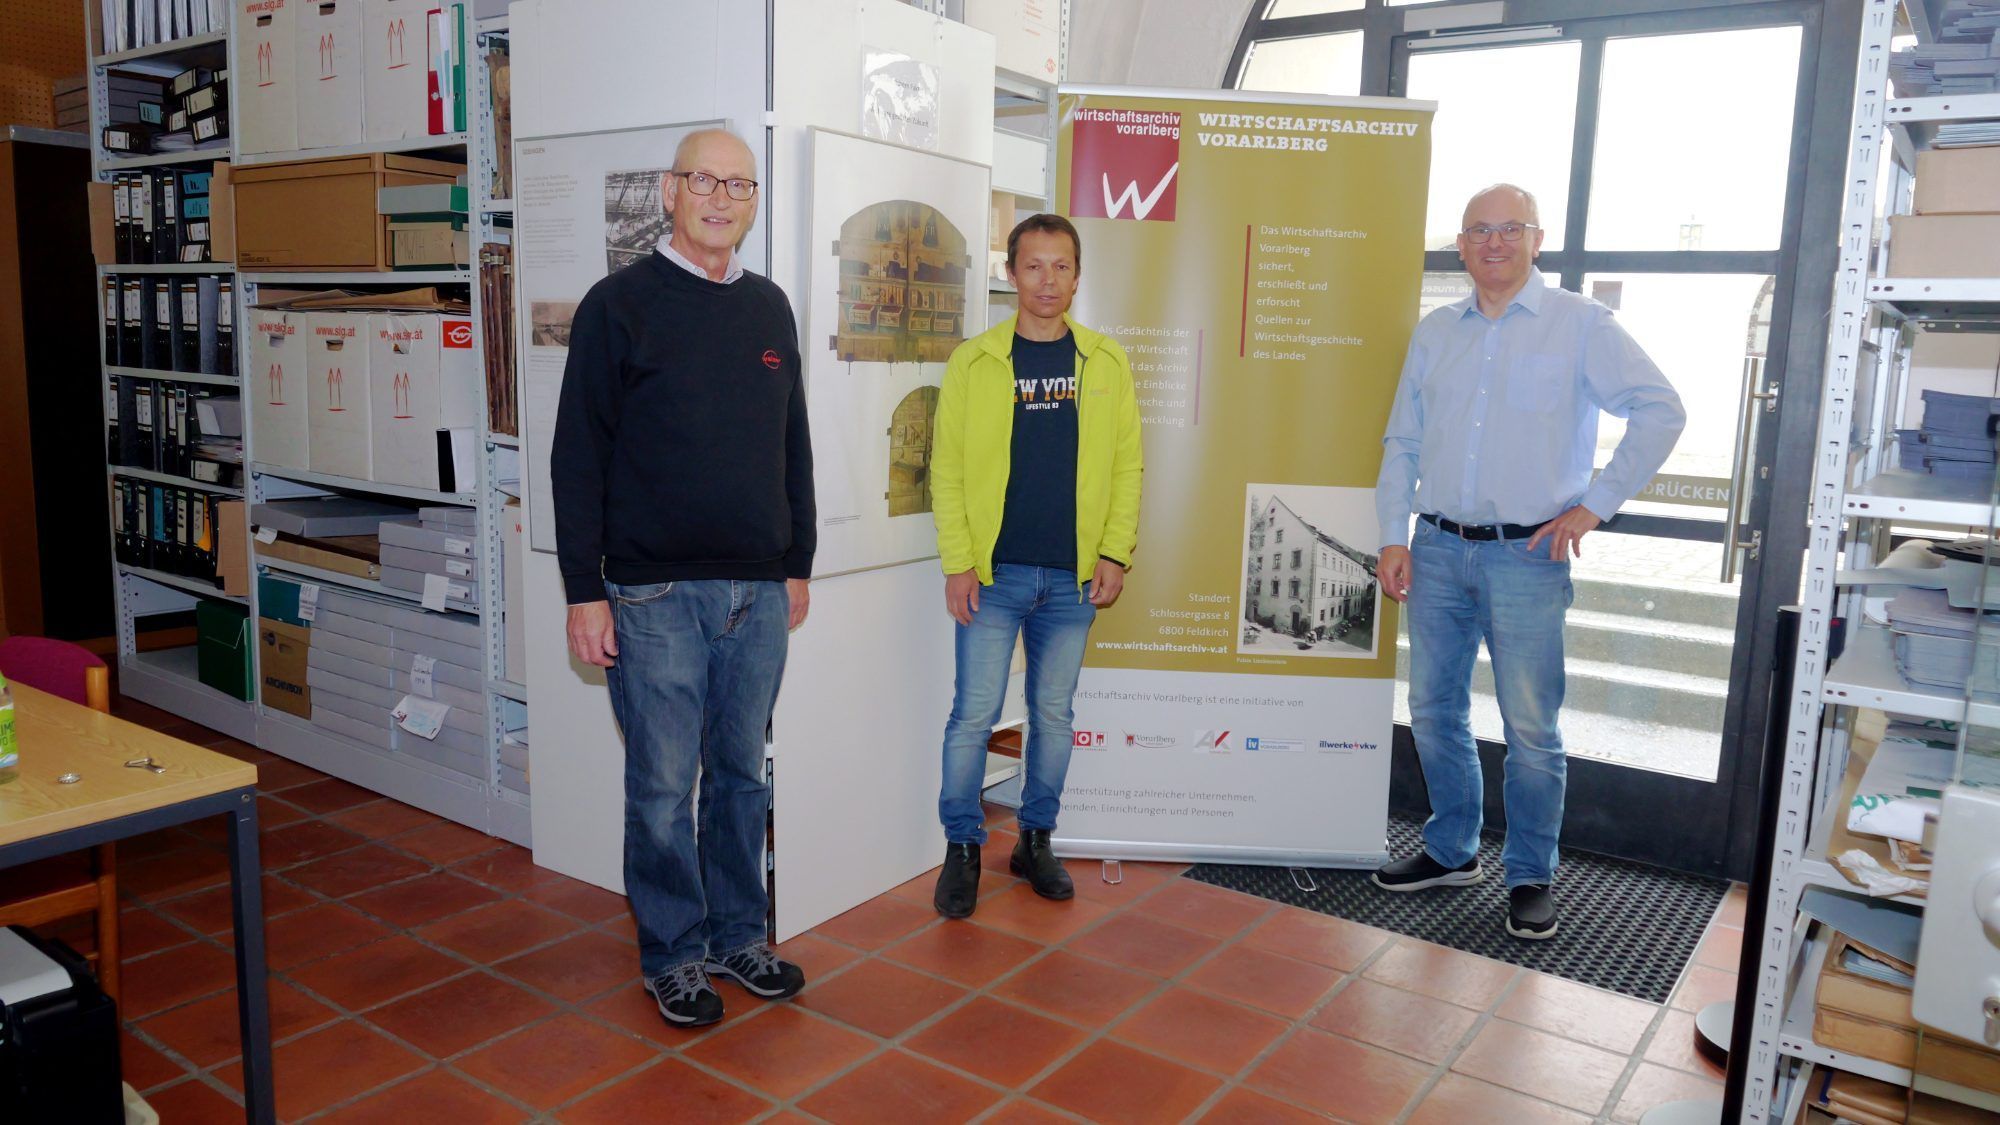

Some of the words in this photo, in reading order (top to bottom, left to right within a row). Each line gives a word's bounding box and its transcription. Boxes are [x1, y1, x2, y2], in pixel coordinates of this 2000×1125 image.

[1074, 109, 1180, 124] wirtschaftsarchiv
[1198, 113, 1418, 136] WIRTSCHAFTSARCHIV
[1116, 124, 1180, 140] vorarlberg
[1198, 133, 1328, 151] VORARLBERG
[1261, 225, 1279, 235] Das
[1281, 226, 1368, 239] Wirtschaftsarchiv
[1260, 244, 1311, 256] Vorarlberg
[1258, 261, 1294, 272] sichert,
[1257, 280, 1306, 290] erschließt
[1308, 282, 1328, 291] und
[1256, 296, 1300, 308] erforscht
[1255, 314, 1293, 325] Quellen
[1296, 317, 1312, 326] zur
[1098, 325, 1113, 334] Als
[1116, 326, 1171, 337] Gedächtnis
[1173, 328, 1190, 337] der
[1254, 332, 1363, 346] Wirtschaftsgeschichte
[1136, 344, 1188, 355] Wirtschaft
[1253, 350, 1270, 359] des
[1273, 350, 1306, 360] Landes
[1138, 362, 1154, 371] das
[1156, 363, 1188, 373] Archiv
[1144, 380, 1186, 390] Einblicke
[1166, 398, 1186, 408] und
[1644, 481, 1730, 502] DRÜCKEN
[1188, 593, 1231, 604] Standort
[1150, 609, 1221, 622] Schlossergasse
[1224, 612, 1230, 620] 8
[1159, 626, 1184, 636] 6800
[1187, 626, 1229, 637] Feldkirch
[1096, 642, 1228, 654] www.wirtschaftsarchiv-v.at
[1154, 693, 1203, 706] Vorarlberg
[1205, 694, 1217, 704] ist
[1220, 696, 1240, 705] eine
[1134, 789, 1186, 800] zahlreicher
[1189, 792, 1257, 803] Unternehmen,
[1102, 804, 1167, 816] Einrichtungen
[1170, 808, 1188, 816] und
[1192, 808, 1234, 818] Personen
